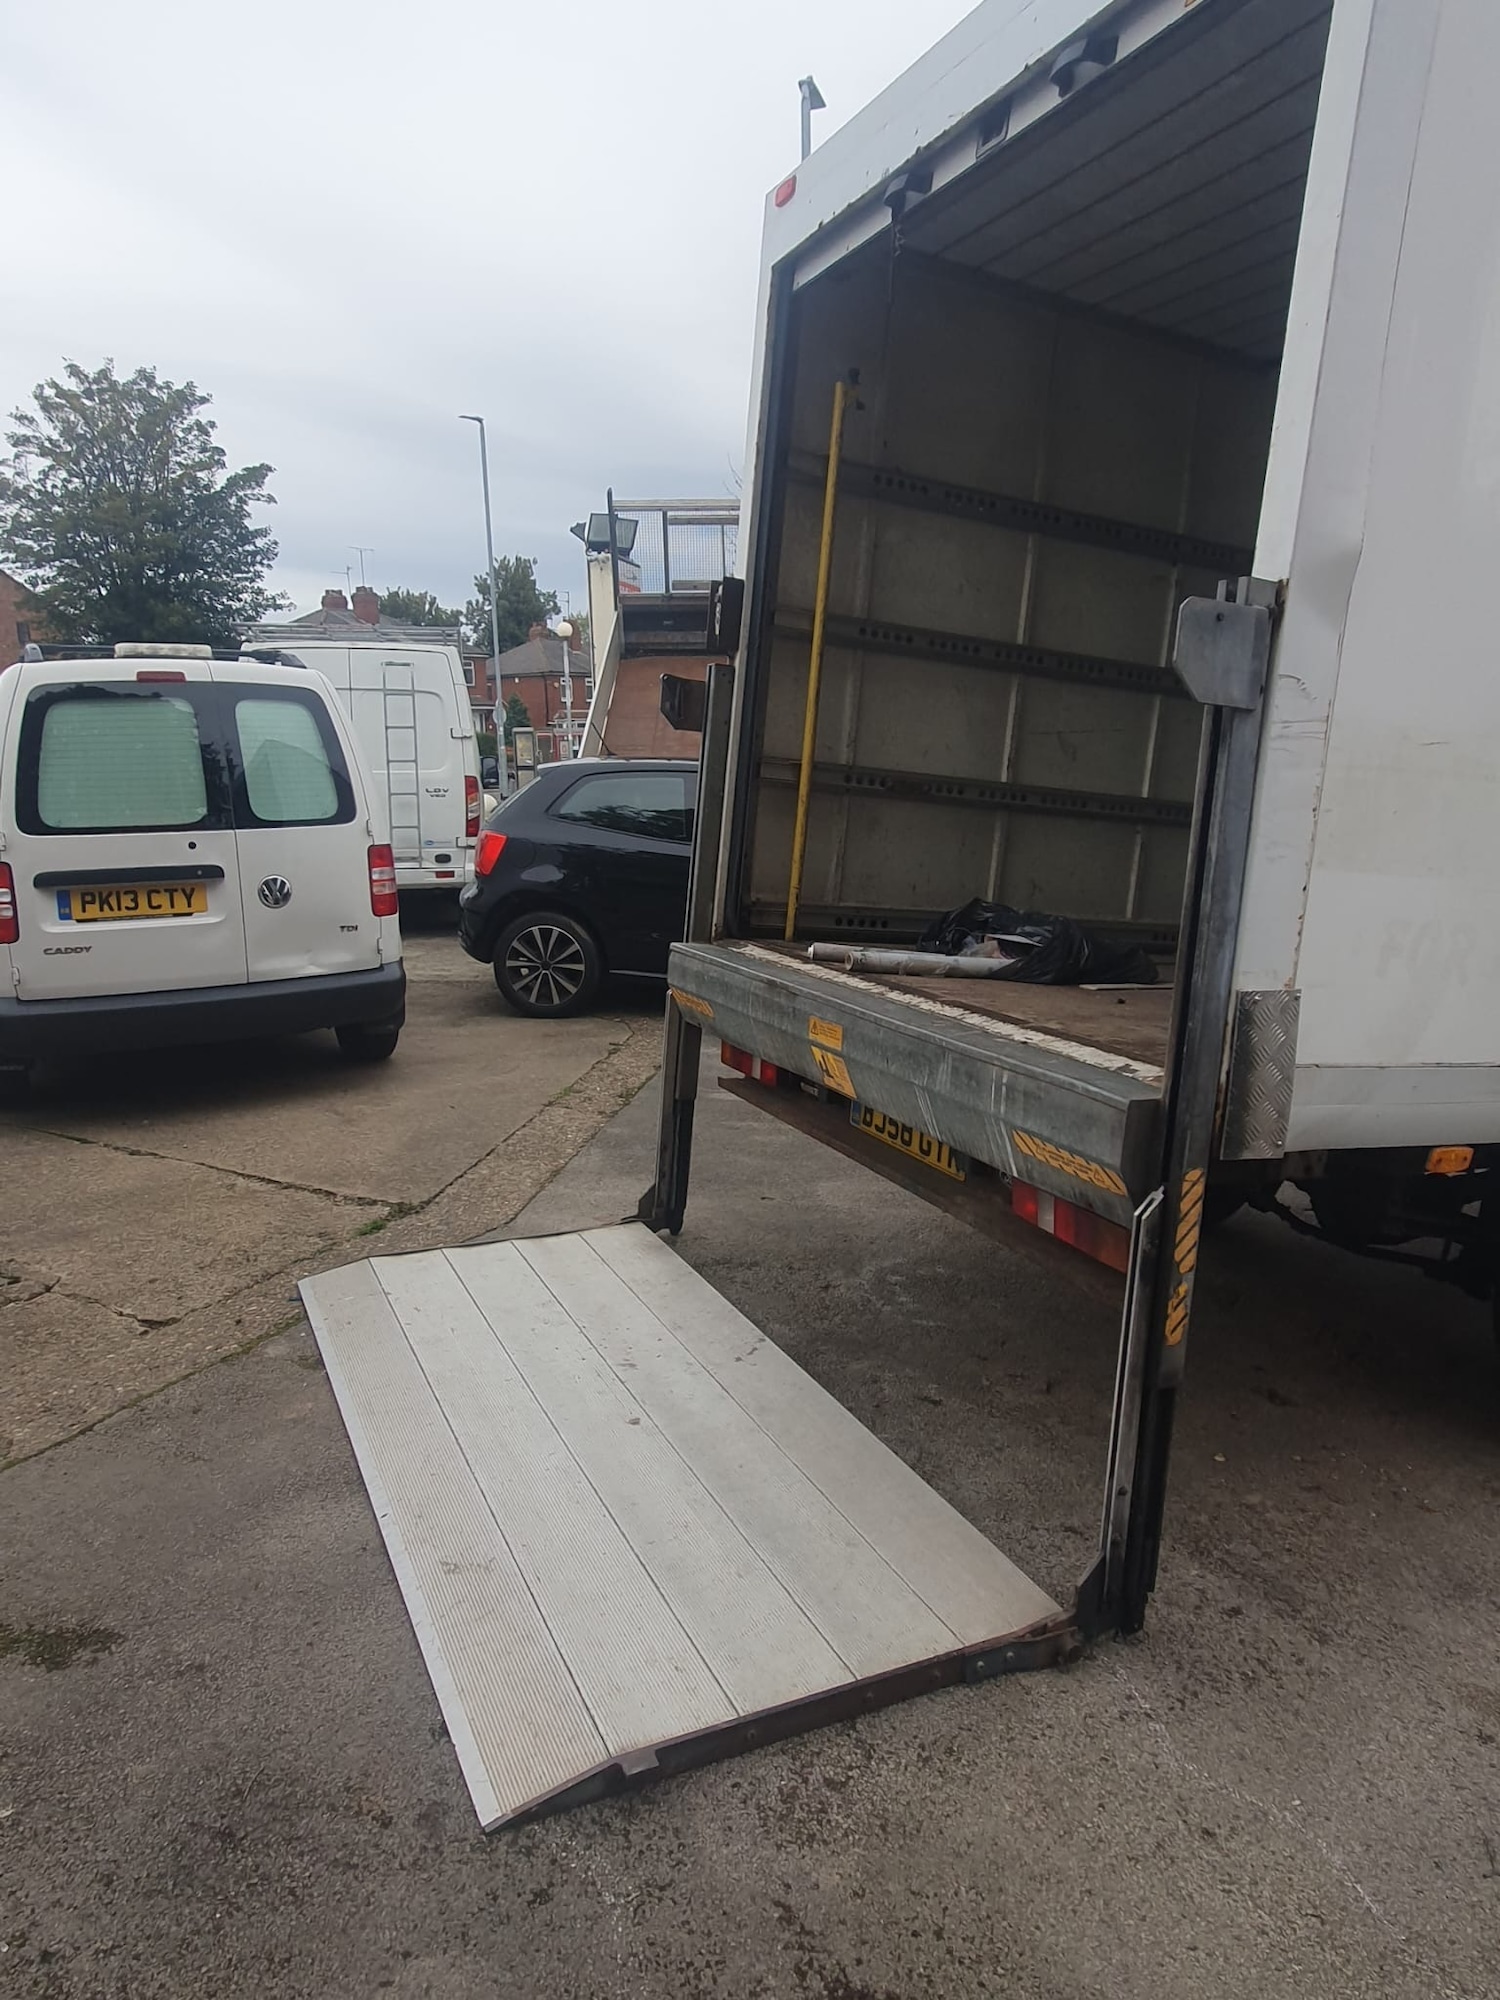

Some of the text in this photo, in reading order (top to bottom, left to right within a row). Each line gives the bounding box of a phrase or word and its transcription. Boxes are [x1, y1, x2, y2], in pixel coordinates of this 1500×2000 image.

[80, 887, 196, 913] PK13 CTY
[339, 924, 359, 933] TDI
[43, 945, 93, 956] CADDY
